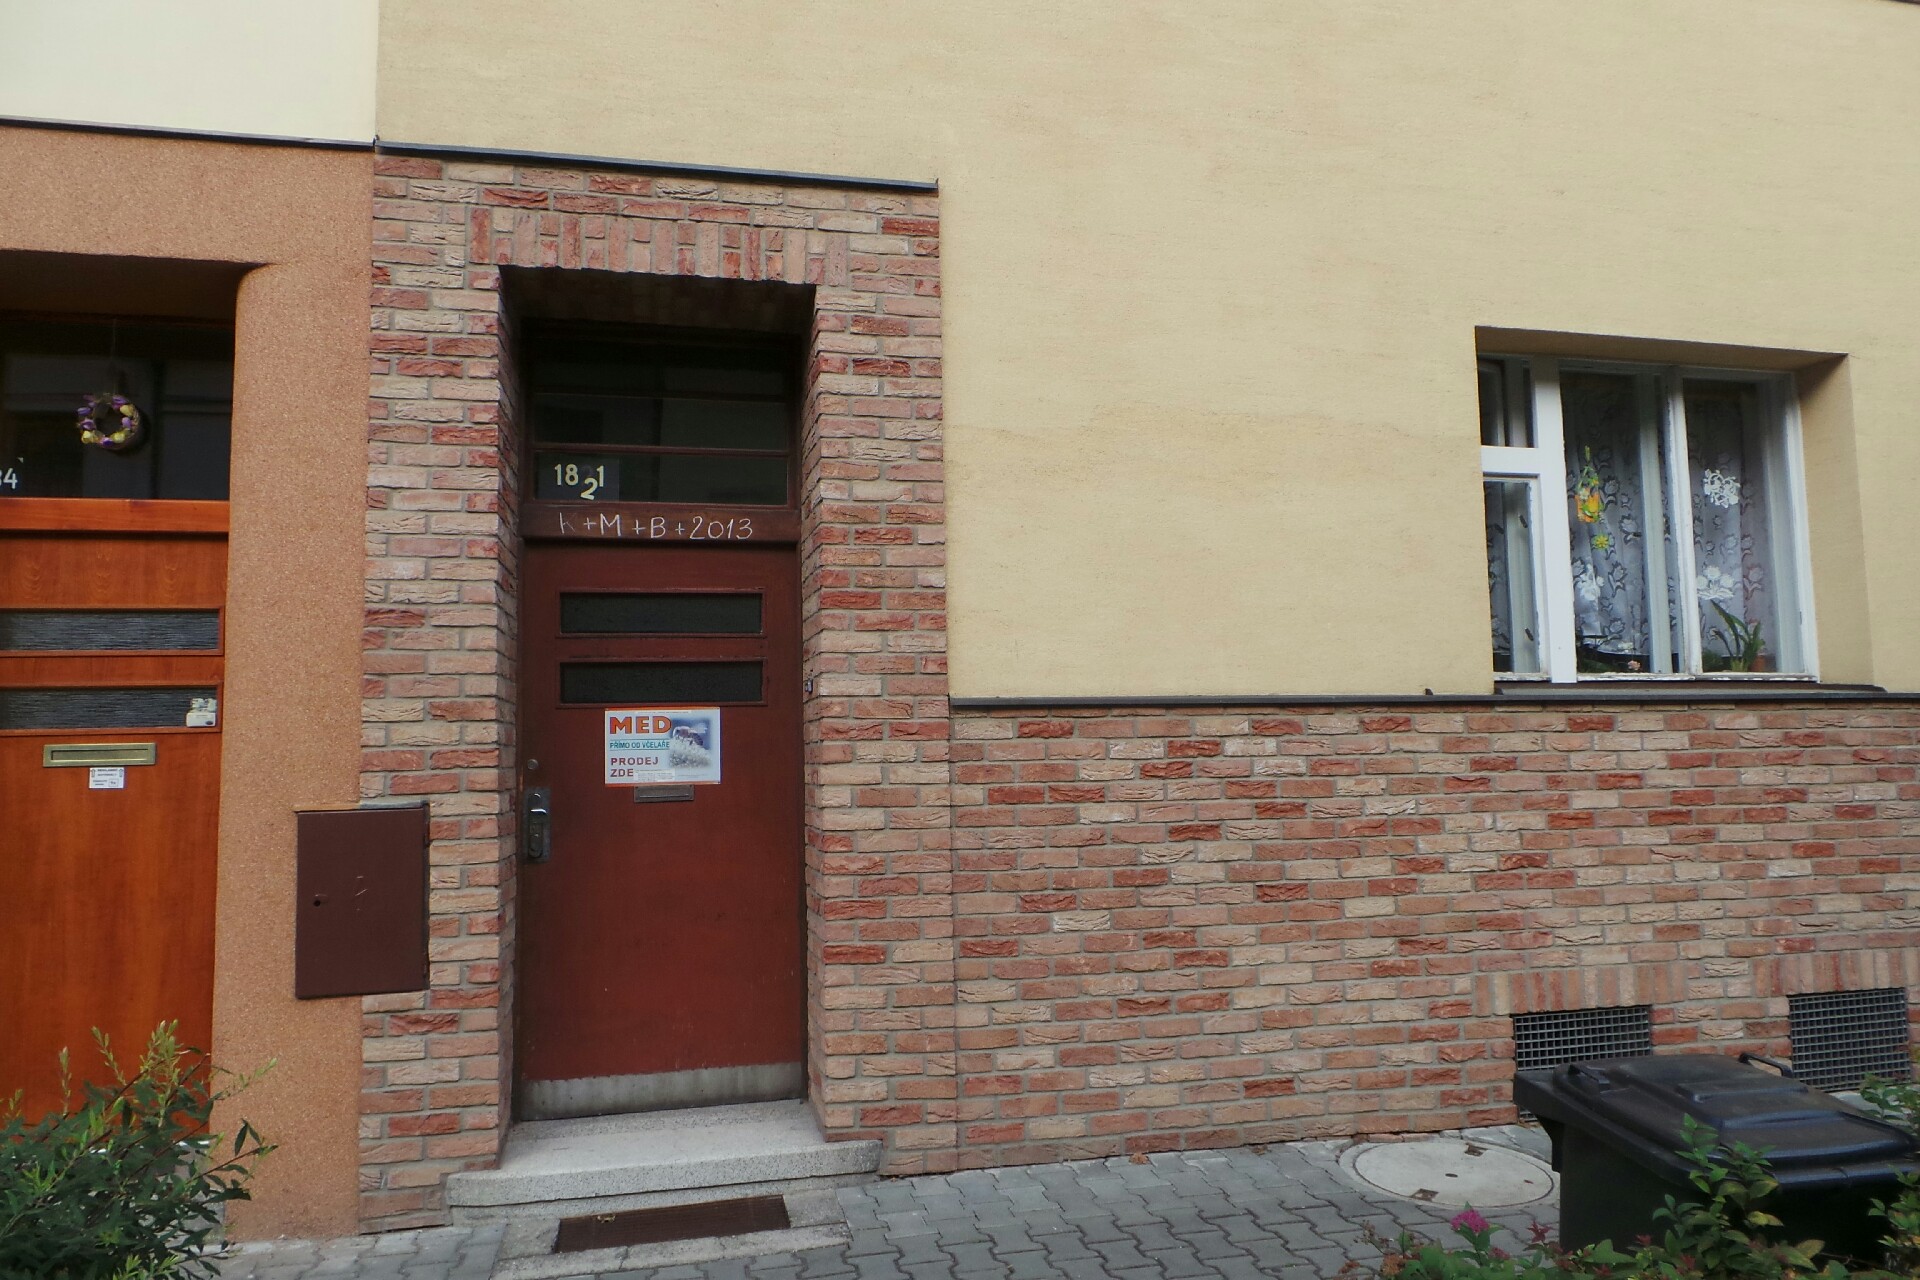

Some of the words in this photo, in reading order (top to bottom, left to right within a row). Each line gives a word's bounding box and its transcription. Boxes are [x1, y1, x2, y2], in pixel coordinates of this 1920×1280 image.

[0, 467, 18, 490] 4
[554, 463, 605, 500] 1821
[609, 715, 672, 734] MED
[631, 740, 641, 749] OD
[642, 739, 670, 748] VČELAŘE
[610, 756, 659, 766] PRODEJ
[610, 768, 634, 778] ZDE
